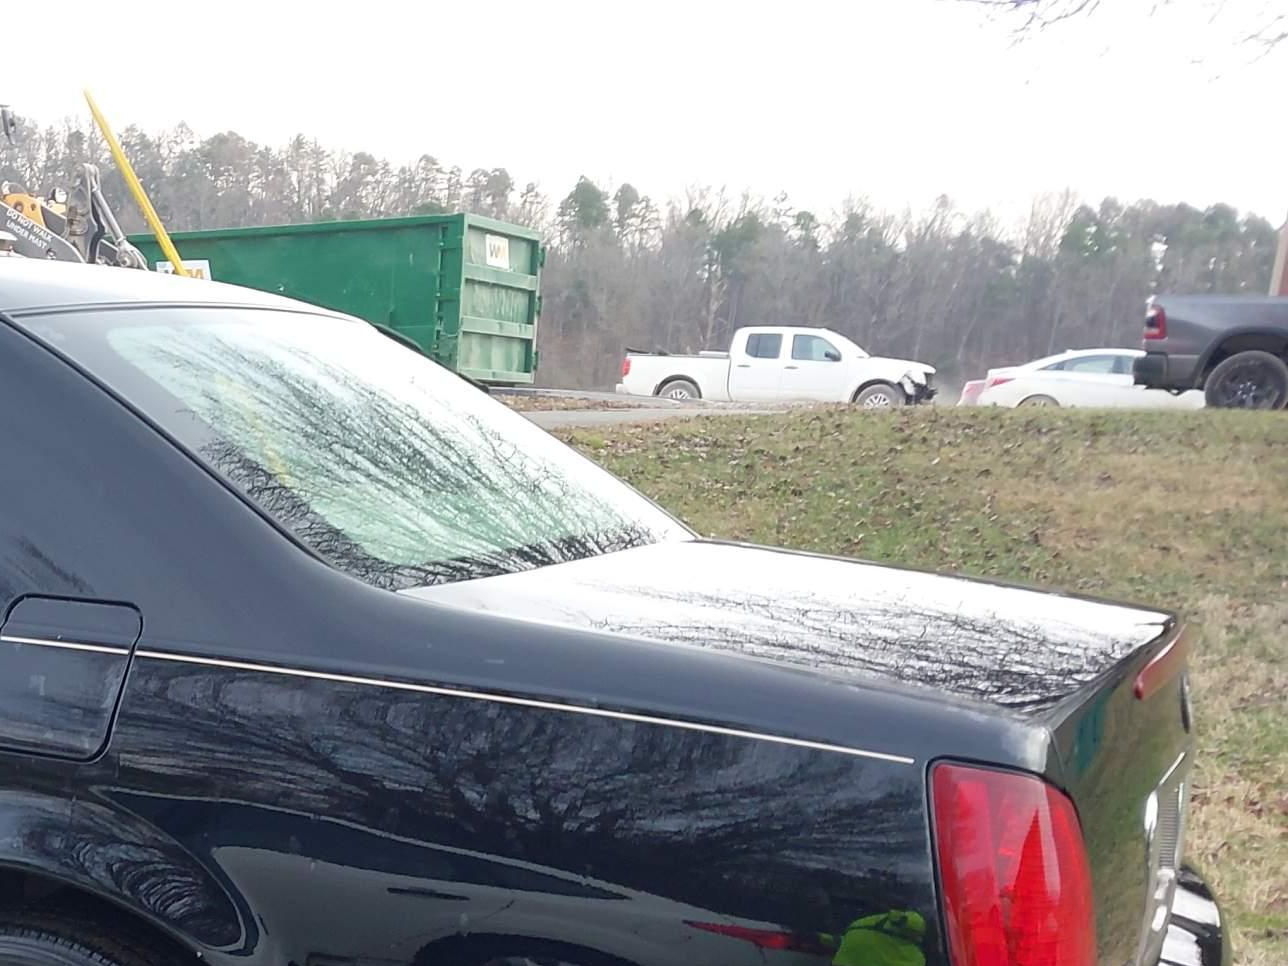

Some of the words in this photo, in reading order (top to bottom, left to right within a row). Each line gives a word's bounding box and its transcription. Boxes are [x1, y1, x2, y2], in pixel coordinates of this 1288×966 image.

[6, 208, 18, 220] DO
[17, 215, 33, 229] NOT
[32, 226, 53, 242] WALK
[28, 234, 47, 249] MAST
